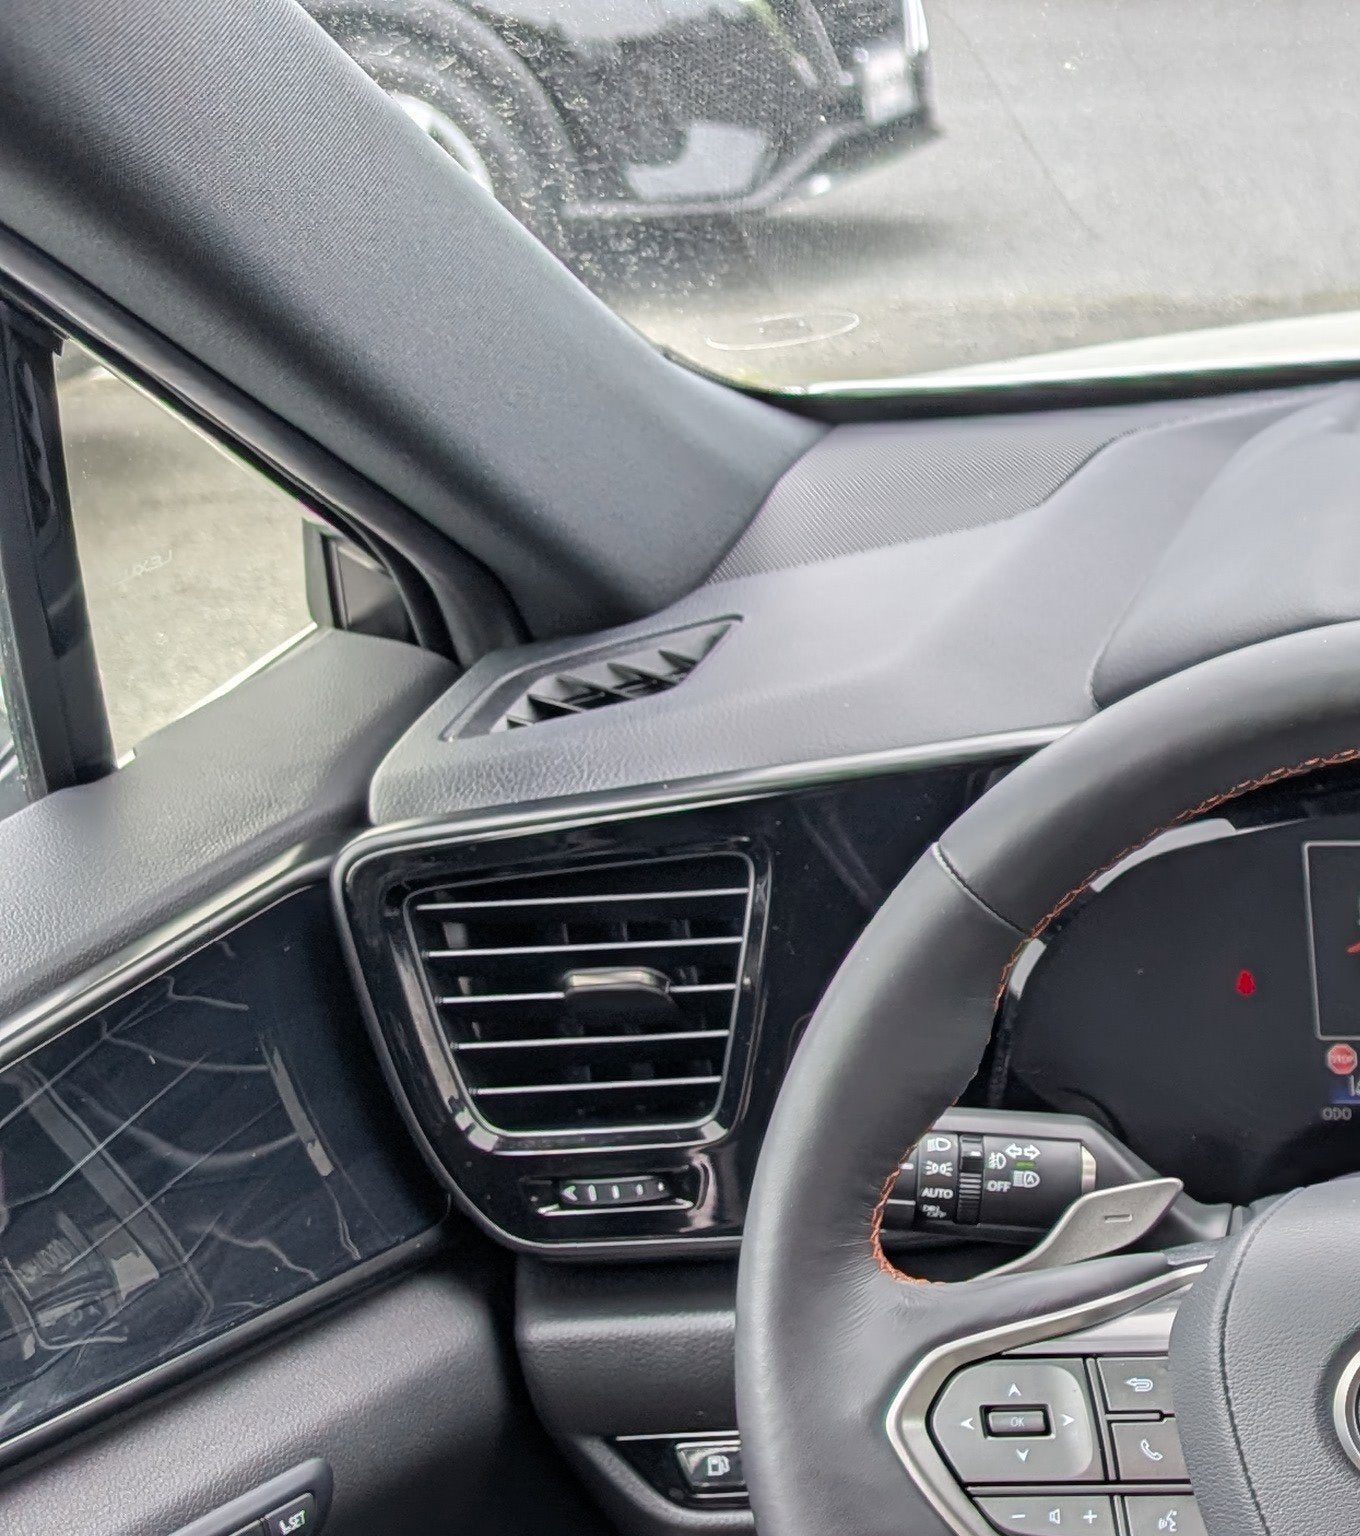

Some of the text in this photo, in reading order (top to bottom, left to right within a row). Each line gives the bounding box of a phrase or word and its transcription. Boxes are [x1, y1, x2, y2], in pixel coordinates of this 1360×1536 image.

[1322, 1107, 1352, 1121] ODO
[987, 1180, 1012, 1193] OFF
[921, 1187, 954, 1199] AUTO
[1010, 1416, 1025, 1428] OK
